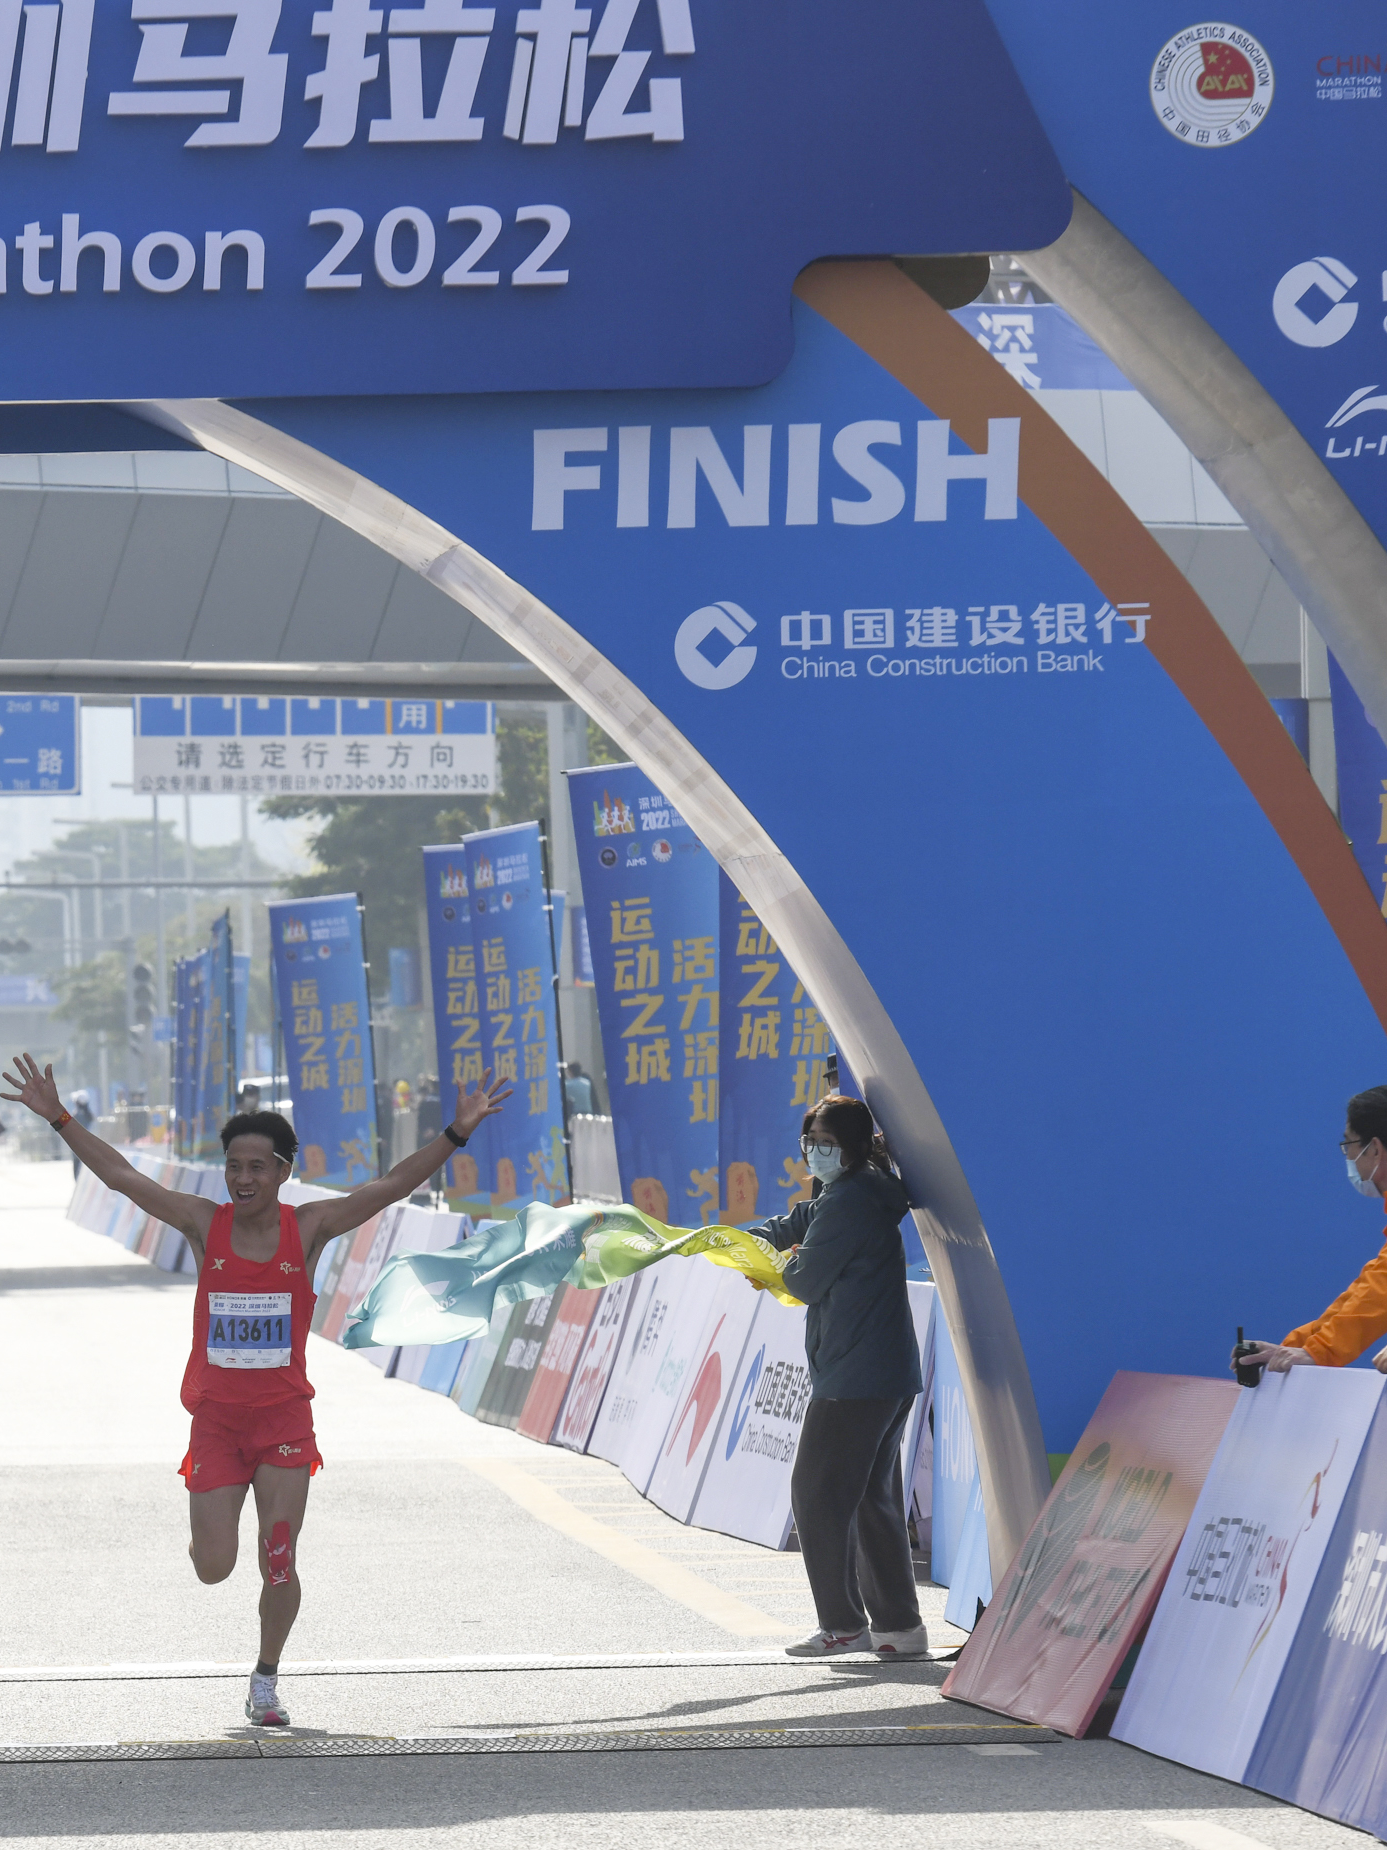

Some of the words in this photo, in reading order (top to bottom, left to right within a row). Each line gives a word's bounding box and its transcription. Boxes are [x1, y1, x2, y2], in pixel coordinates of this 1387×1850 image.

[1153, 48, 1178, 92] CHINESE
[1173, 26, 1226, 53] ATHLETICS
[1228, 30, 1271, 88] ASSOCIATION
[1316, 53, 1387, 77] CHIN
[1316, 75, 1382, 88] MARATHON
[1316, 86, 1382, 101] 中国马拉松
[1161, 100, 1266, 145] 中国田径协会
[306, 205, 572, 291] 2022
[1325, 432, 1387, 459] LI-
[531, 416, 1021, 531] FINISH
[779, 601, 1152, 652] 中国建设银行
[780, 654, 856, 680] China
[865, 652, 1029, 678] Construction
[1036, 649, 1104, 673] Bank
[398, 703, 428, 730] 用
[175, 740, 455, 770] 请选定行车方向
[640, 810, 671, 832] 2022
[626, 856, 648, 868] AIMS
[610, 896, 672, 1086] 运动之城
[734, 893, 782, 1061] 动之城
[482, 936, 519, 1084] 运动之城
[291, 978, 331, 1092] 运动之城
[331, 1001, 368, 1114] 活力深圳
[517, 966, 549, 1116] 活力深圳
[213, 1317, 284, 1343] A13611
[755, 1361, 813, 1425] 中国建设银
